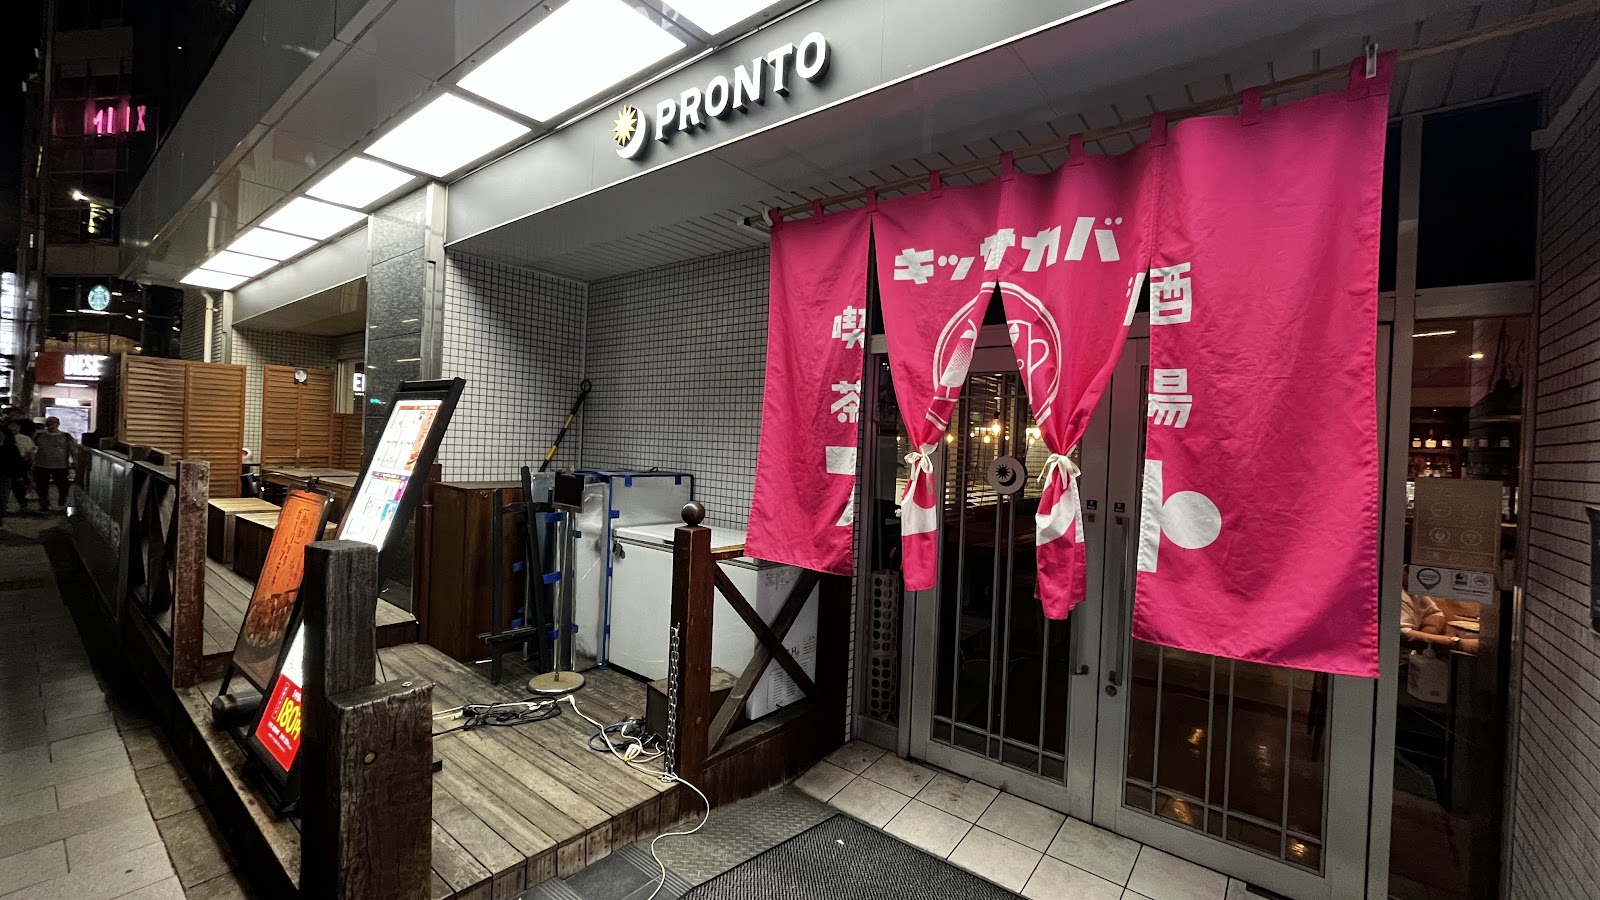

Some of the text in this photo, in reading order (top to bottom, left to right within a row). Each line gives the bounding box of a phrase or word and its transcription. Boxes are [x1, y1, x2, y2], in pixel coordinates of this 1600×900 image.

[654, 31, 830, 141] PRONTO
[893, 216, 1123, 285] キッサカバ
